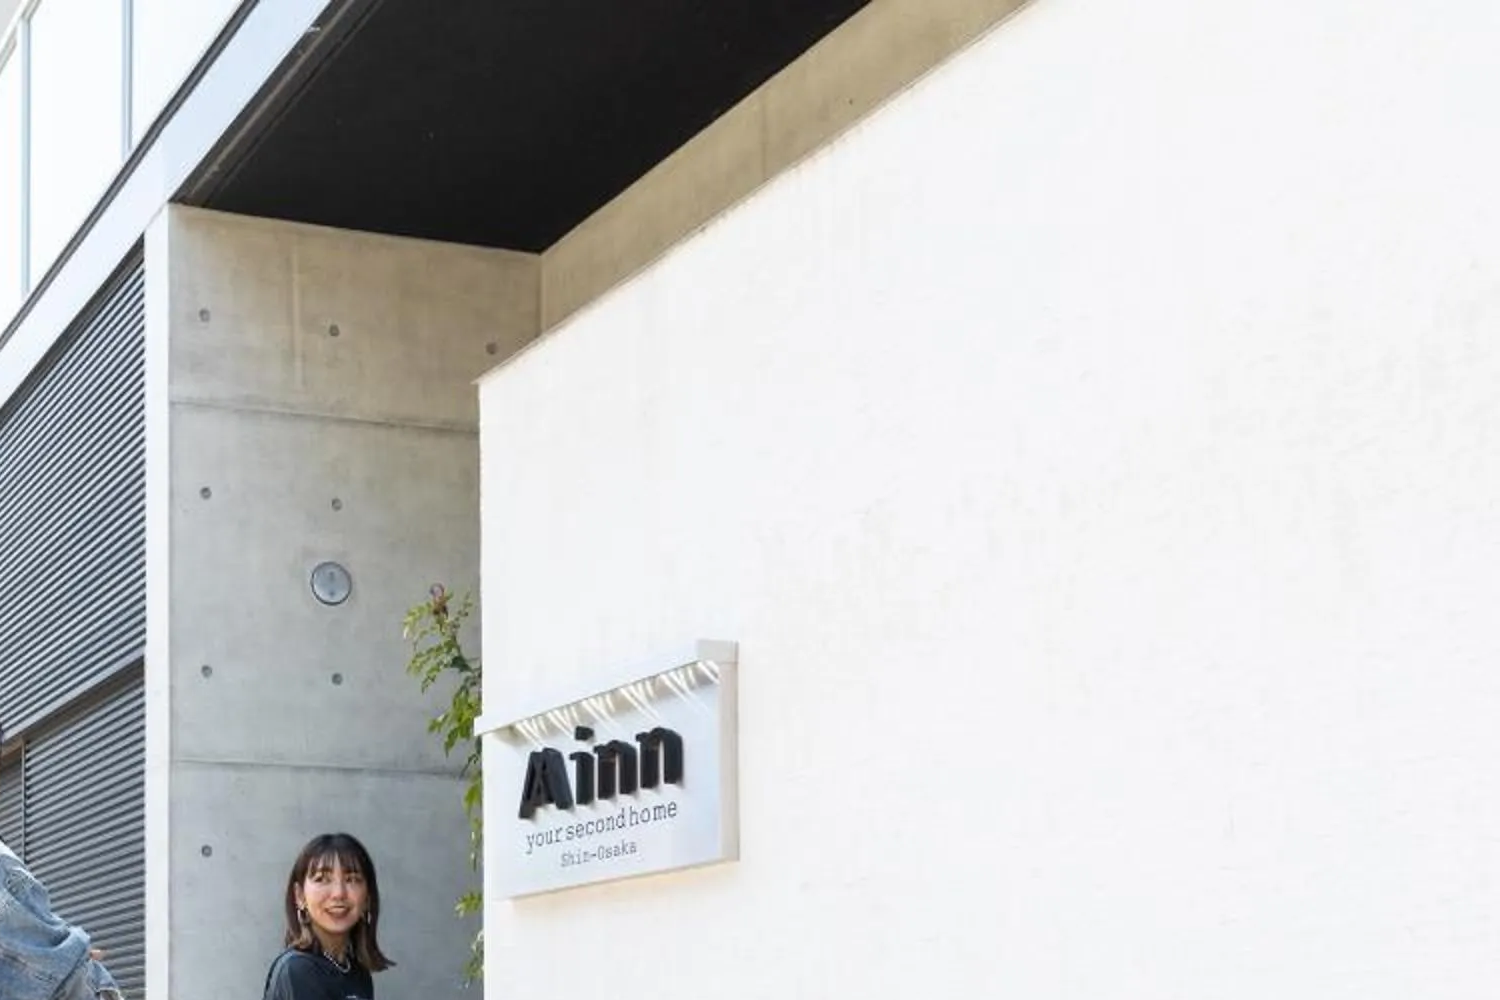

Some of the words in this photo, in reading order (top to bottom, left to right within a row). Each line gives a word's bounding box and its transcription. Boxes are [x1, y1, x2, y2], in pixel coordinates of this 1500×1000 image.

[518, 725, 684, 819] Ainn
[526, 826, 563, 854] your
[565, 807, 625, 841] second
[629, 801, 677, 826] home
[560, 839, 637, 867] Shin-Osaka
